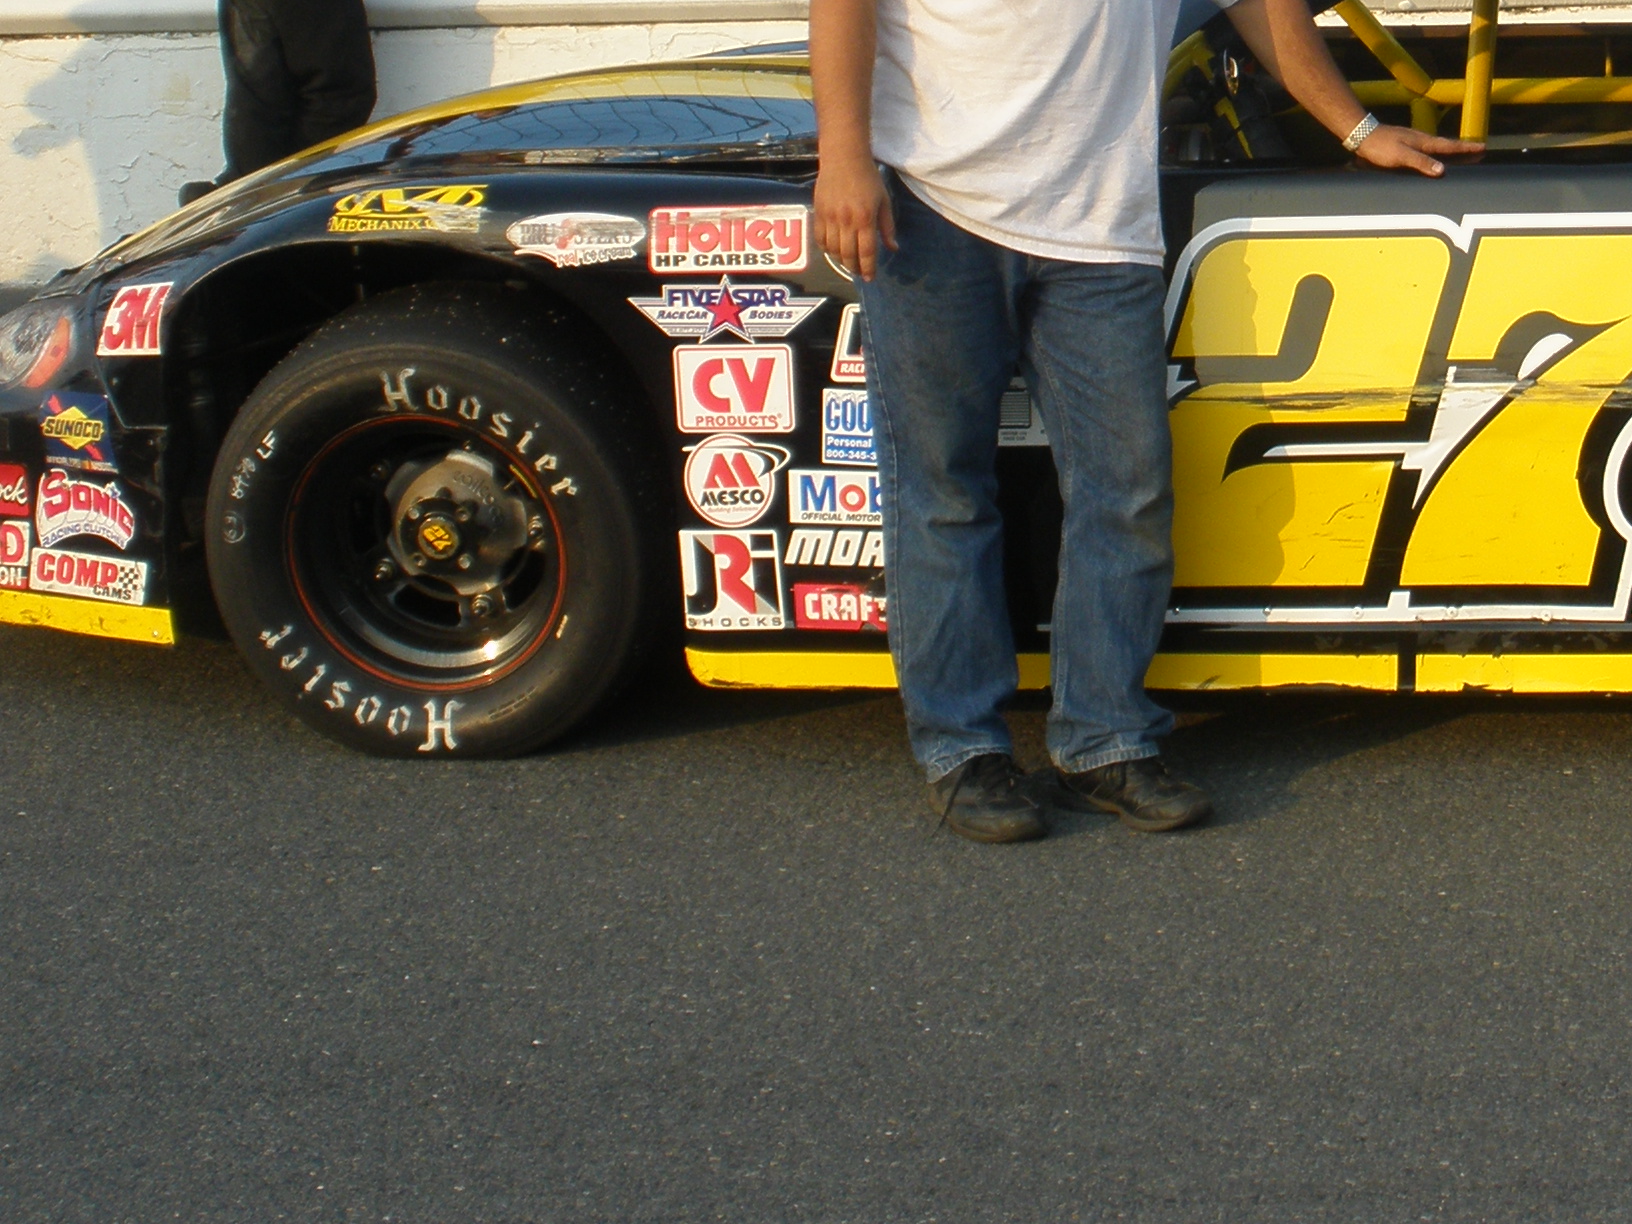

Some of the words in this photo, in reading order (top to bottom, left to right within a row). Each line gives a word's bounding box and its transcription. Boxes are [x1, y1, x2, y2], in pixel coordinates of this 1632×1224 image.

[329, 216, 421, 232] MECHANIX
[655, 212, 802, 265] Holley
[656, 254, 689, 267] HP
[693, 253, 775, 266] CARBS
[667, 289, 719, 307] FIVE
[731, 289, 788, 307] STAR
[104, 285, 171, 350] 3M
[749, 310, 793, 319] BODIES
[840, 363, 864, 373] RACI
[692, 357, 776, 413] CV
[695, 415, 779, 427] PRODUCTS
[825, 393, 873, 433] COO
[44, 420, 102, 440] SUNOCO
[378, 367, 578, 497] Hoosier
[827, 436, 872, 448] Personal
[826, 448, 877, 460] 800-345-3
[41, 469, 134, 539] SONIC
[700, 489, 765, 506] MESCO
[801, 475, 882, 513] Mob
[801, 513, 842, 522] OFFICIAL
[845, 513, 881, 522] MOTOR
[42, 523, 82, 547] RACING
[84, 524, 126, 549] CLUTCHES
[784, 530, 884, 567] MOR
[36, 553, 118, 588] COMP
[93, 585, 132, 600] CAMS
[804, 593, 886, 623] CRAFT
[688, 617, 783, 627] SHOCKS
[258, 624, 465, 752] Hoosier
